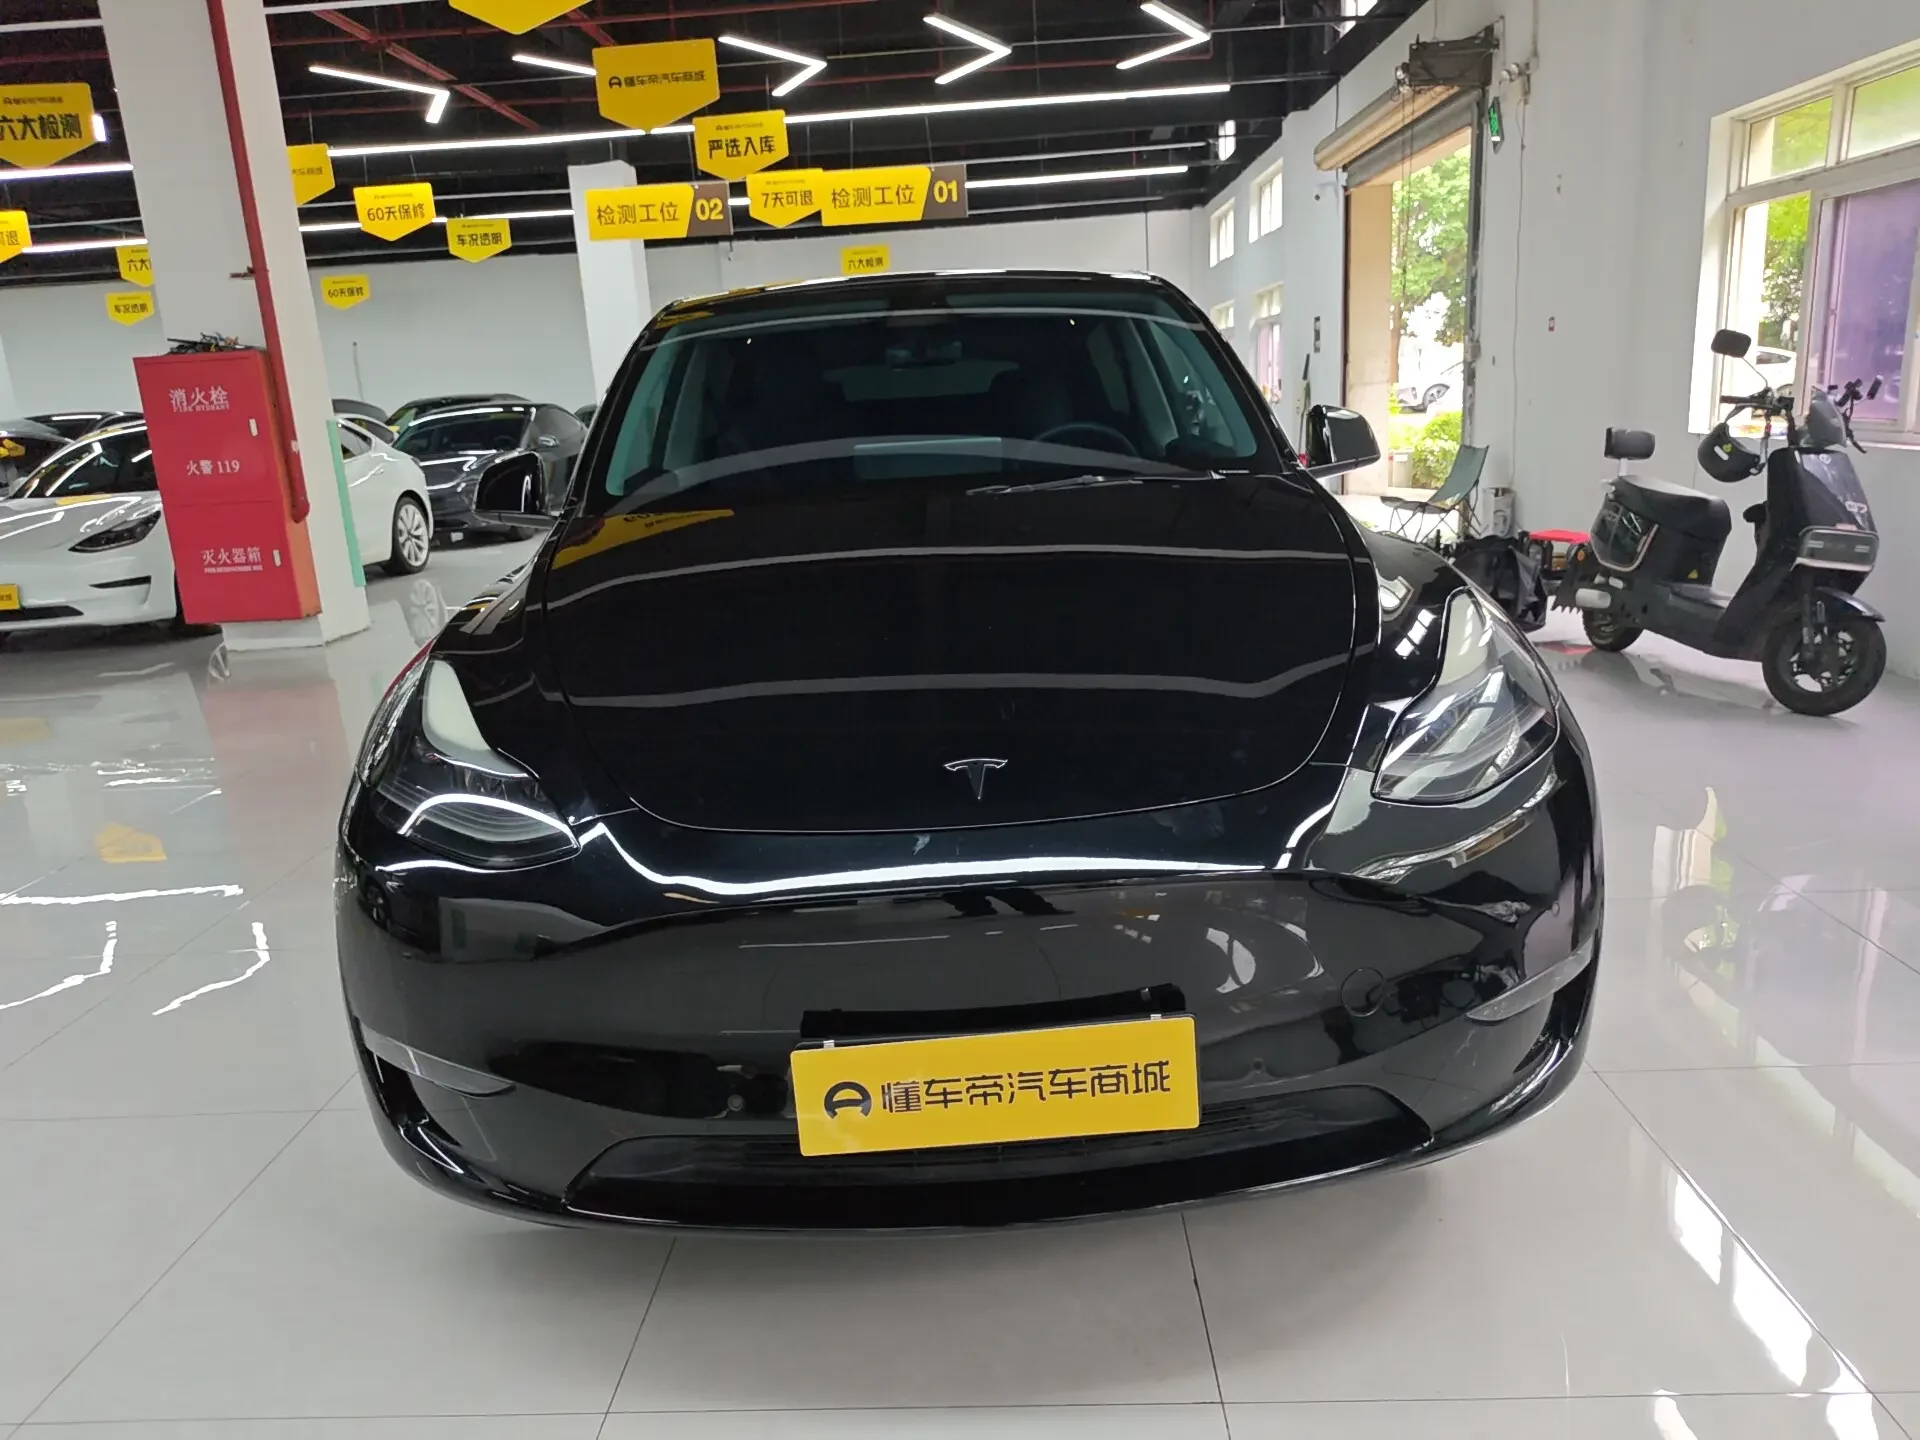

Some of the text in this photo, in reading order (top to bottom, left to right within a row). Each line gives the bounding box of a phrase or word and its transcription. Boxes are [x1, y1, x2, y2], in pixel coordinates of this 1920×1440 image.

[0, 113, 82, 141] 六大检测
[708, 135, 776, 159] 严选入库
[761, 190, 813, 208] 7天可退
[831, 180, 958, 209] 检测工位 01
[366, 203, 426, 221] 60天保修
[597, 197, 724, 226] 检测工位 02
[456, 233, 503, 247] 车况透明
[127, 258, 152, 272] 六大
[169, 386, 228, 406] 消火栓
[186, 460, 240, 476] 火警 119
[201, 547, 261, 565] 灭火器箱
[880, 1060, 1170, 1114] 懂车帝汽车商城
